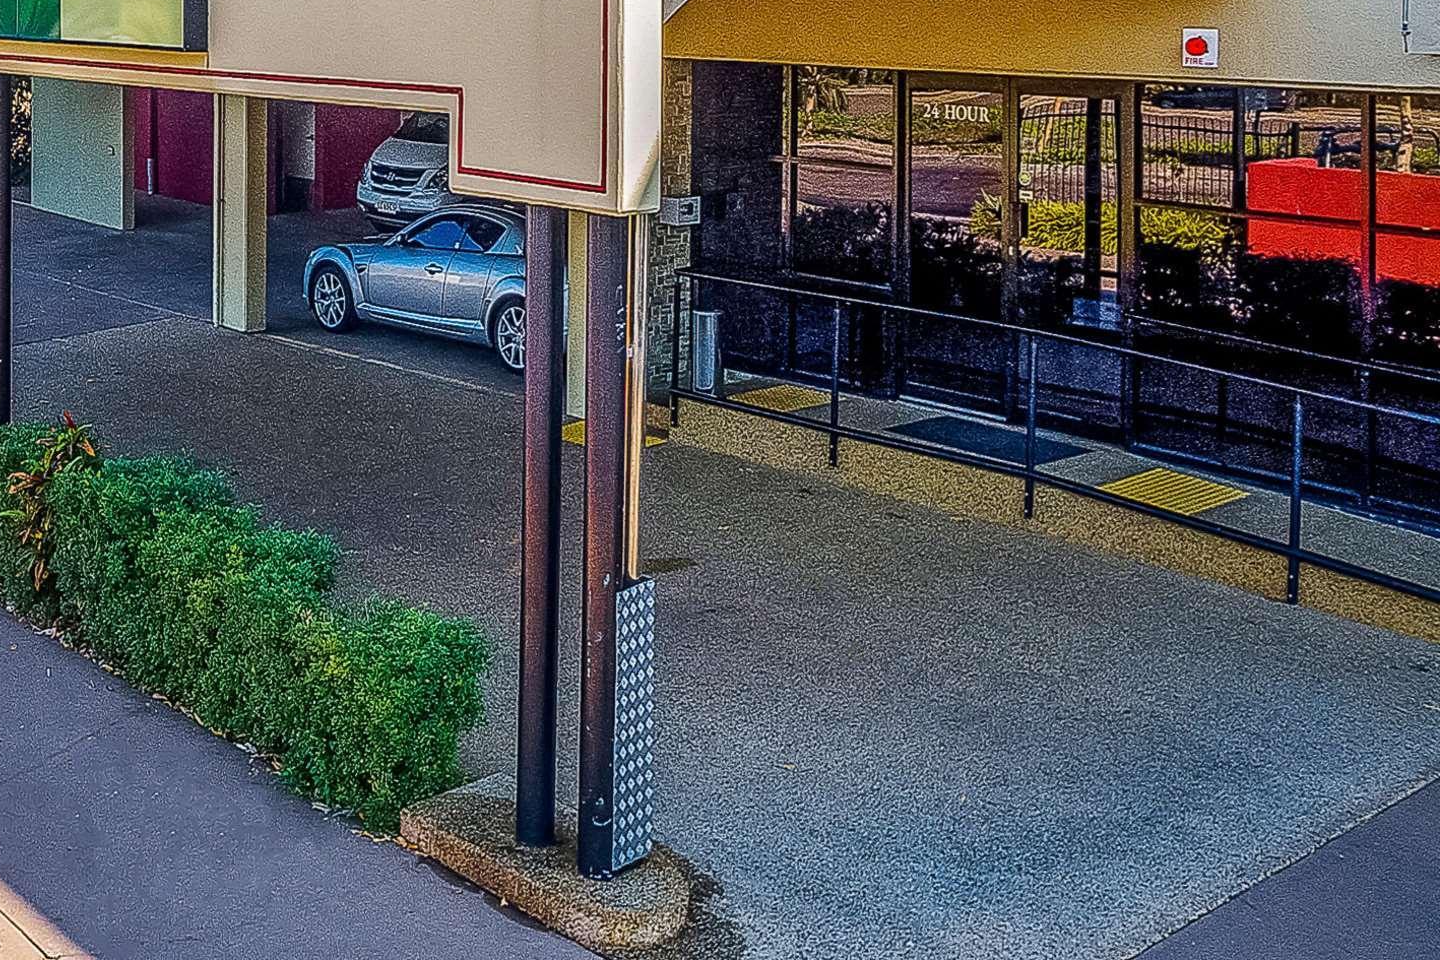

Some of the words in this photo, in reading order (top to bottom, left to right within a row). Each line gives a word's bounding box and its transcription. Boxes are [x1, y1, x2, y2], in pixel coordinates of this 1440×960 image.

[1185, 57, 1203, 65] FIRE
[923, 103, 939, 118] 24
[944, 104, 990, 122] HOUR
